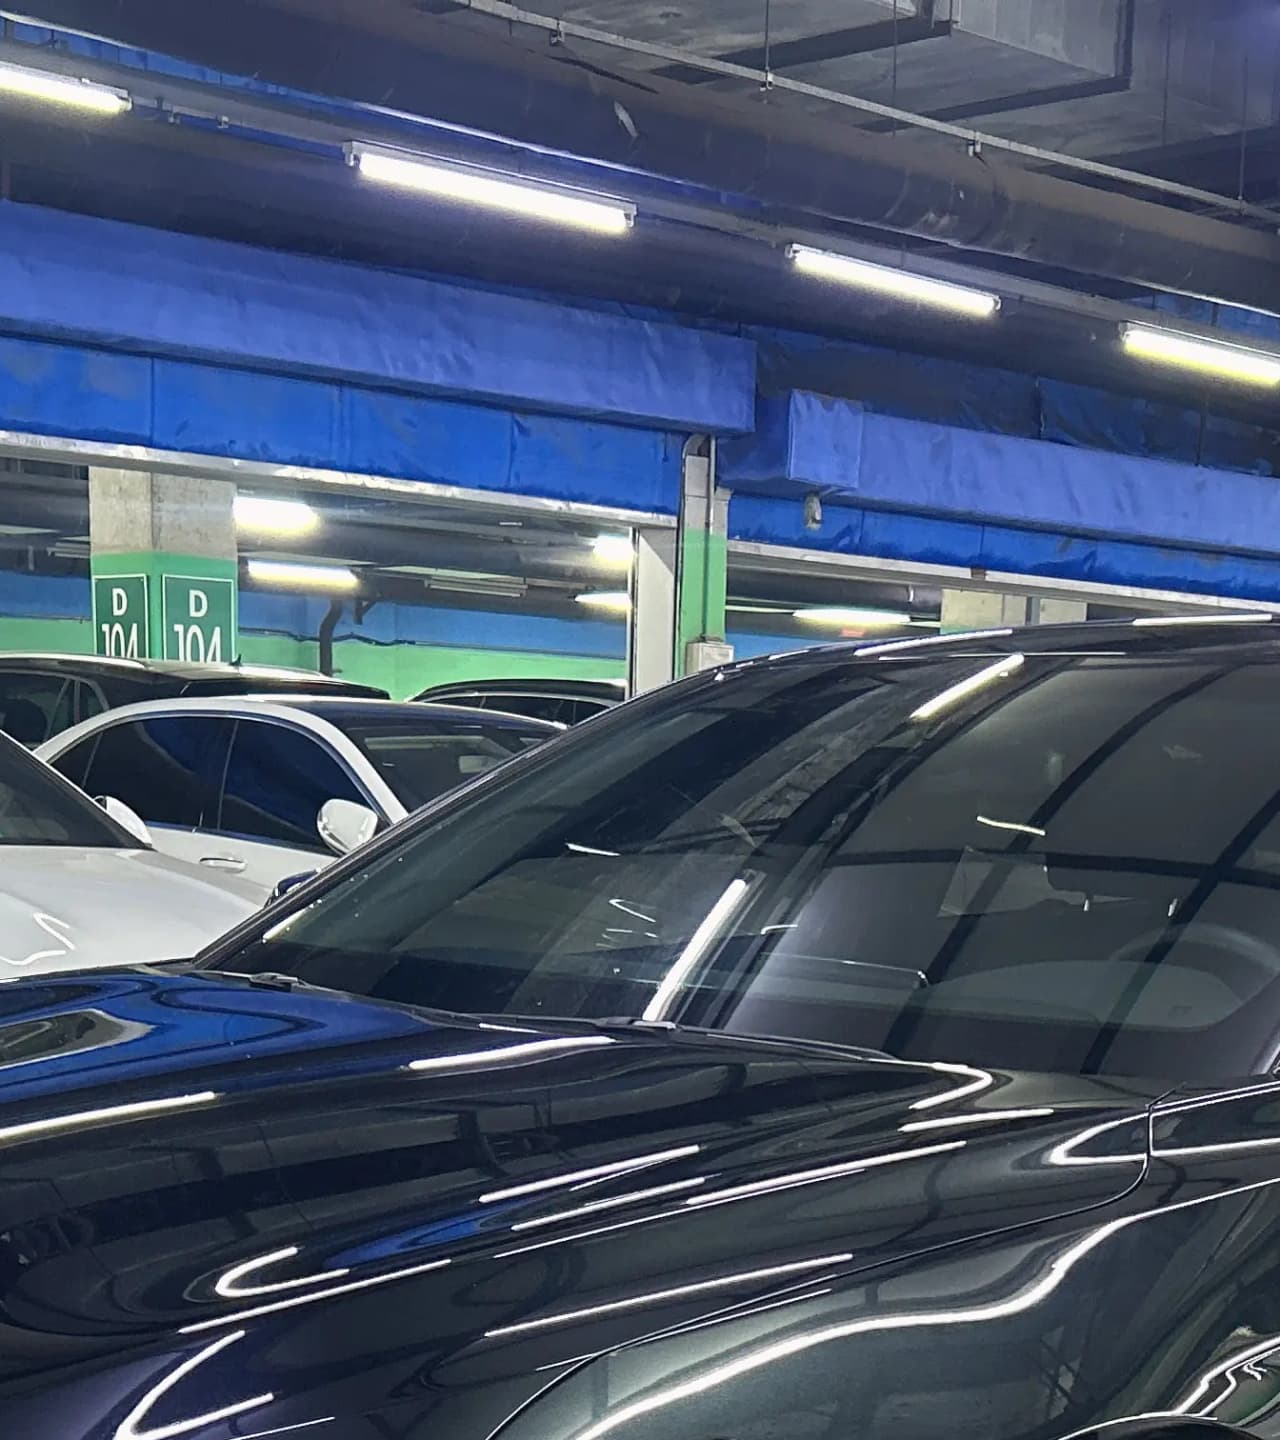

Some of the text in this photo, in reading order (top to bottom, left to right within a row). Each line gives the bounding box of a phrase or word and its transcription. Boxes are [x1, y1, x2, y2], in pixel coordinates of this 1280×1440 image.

[112, 587, 128, 616] D
[189, 589, 208, 618] D
[101, 622, 138, 659] 104
[173, 623, 221, 663] 104
